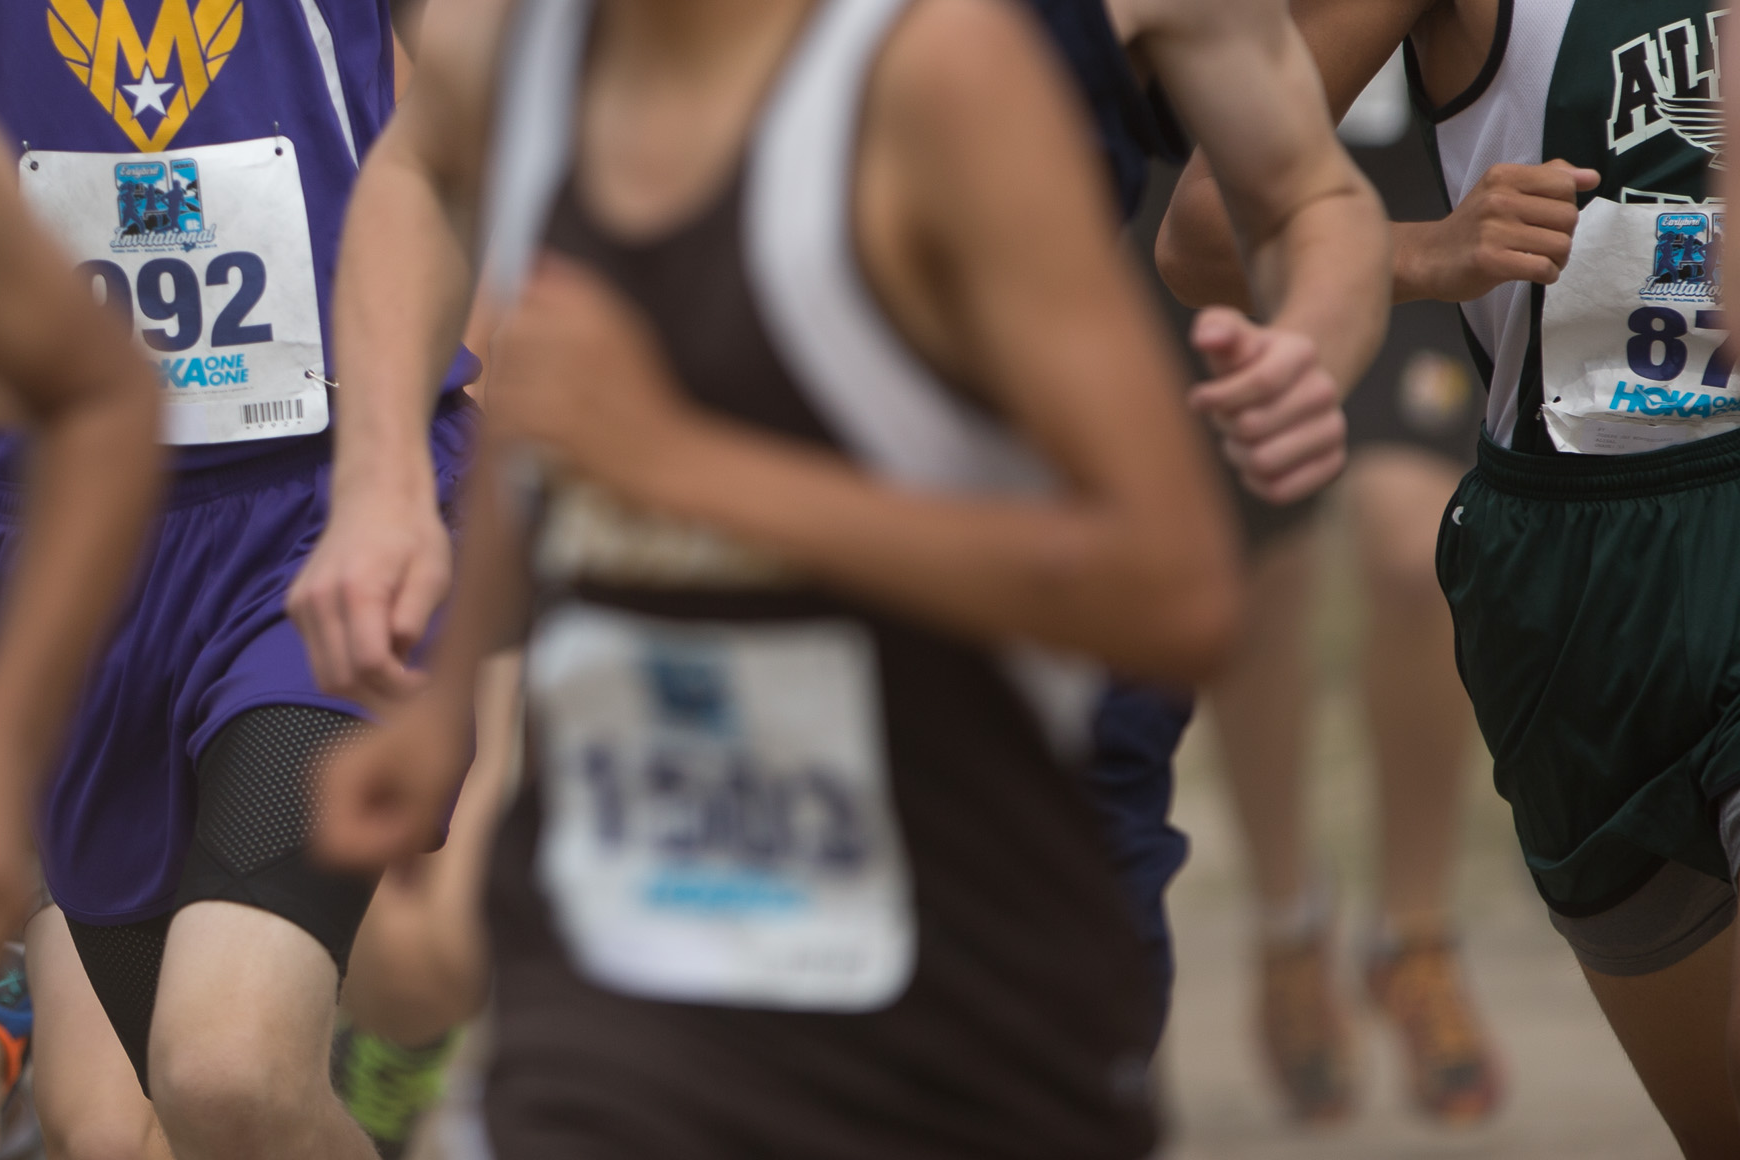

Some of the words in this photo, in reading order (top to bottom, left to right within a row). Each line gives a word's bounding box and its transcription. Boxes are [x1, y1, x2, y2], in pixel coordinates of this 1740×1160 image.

[1662, 216, 1702, 230] Earlybird
[110, 223, 217, 248] Invitational
[205, 353, 245, 371] ONE
[209, 368, 249, 387] ONE
[1609, 381, 1711, 418] HOKA
